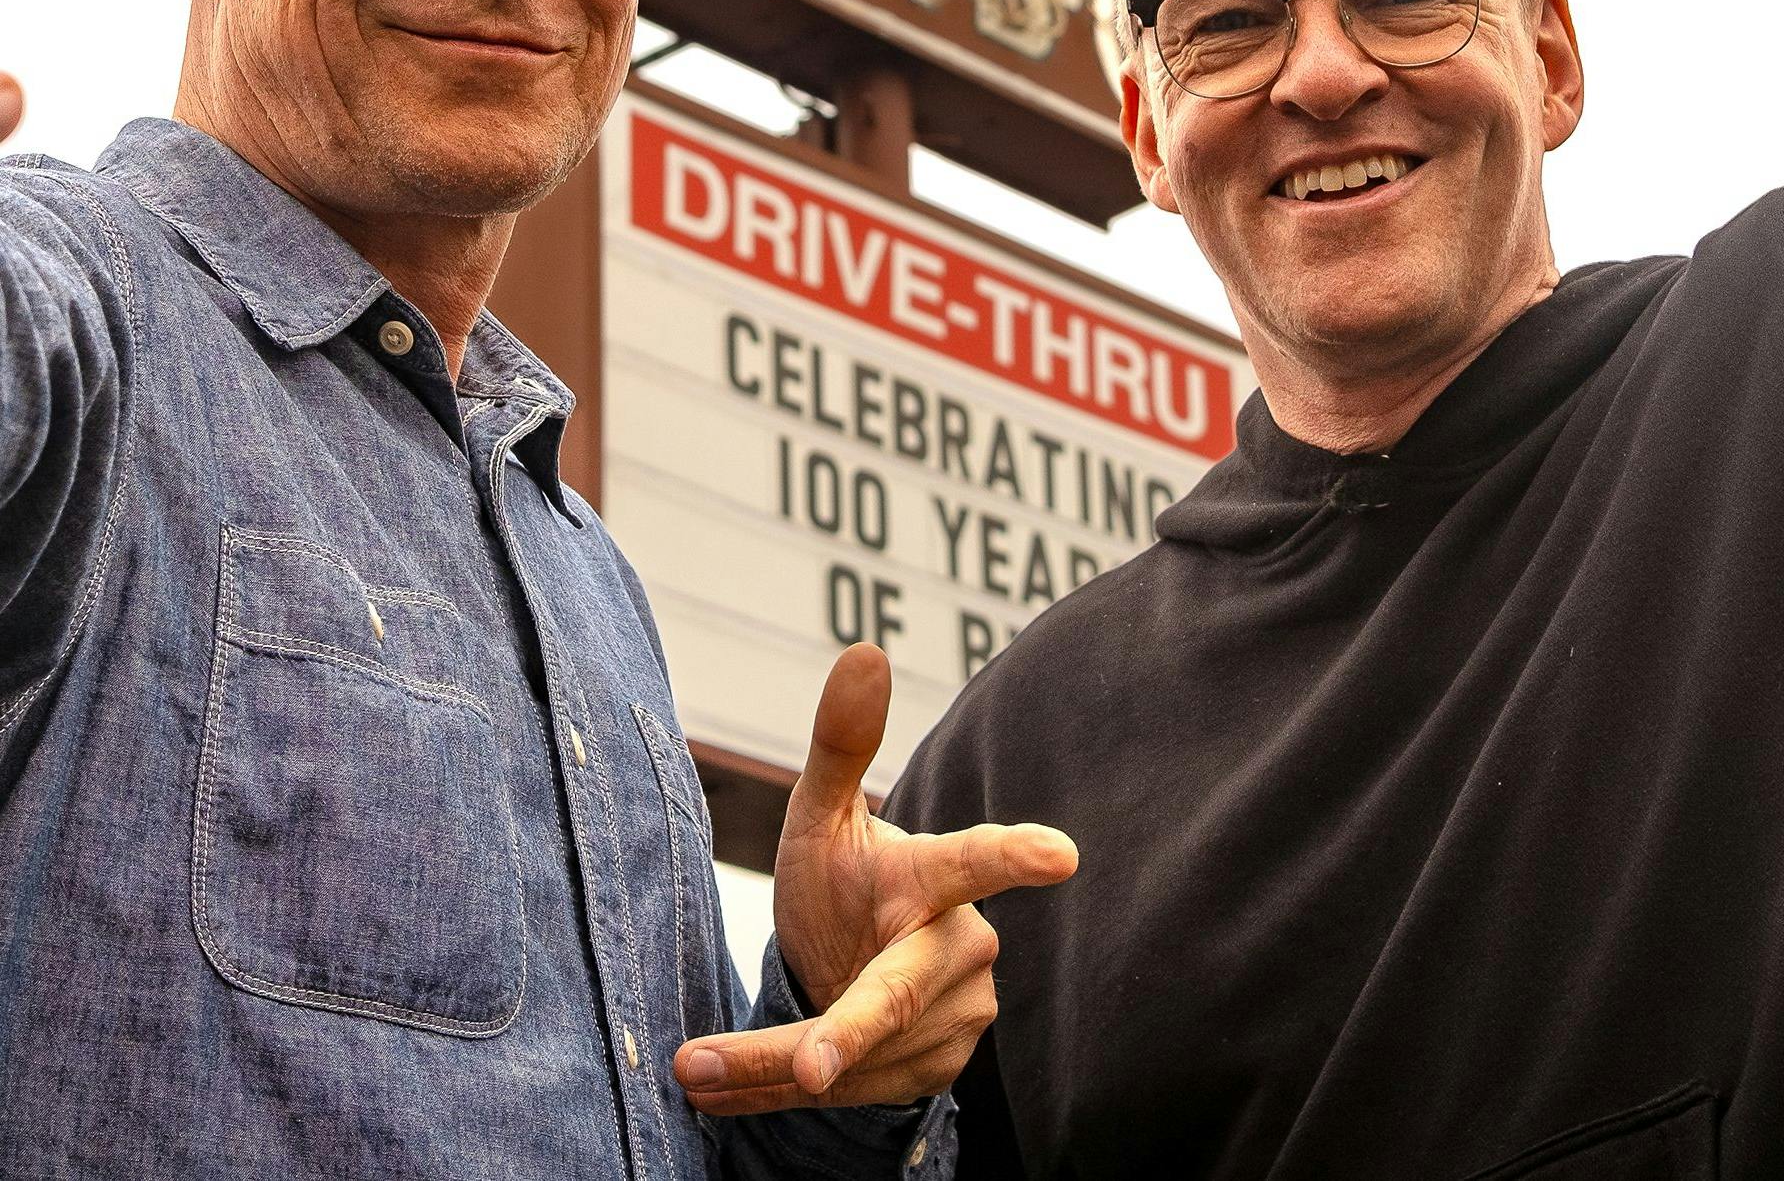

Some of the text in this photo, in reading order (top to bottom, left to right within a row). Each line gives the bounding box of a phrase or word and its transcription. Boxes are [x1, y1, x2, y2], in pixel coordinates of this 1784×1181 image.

[664, 141, 1209, 442] DRIVE-THRU
[779, 437, 889, 553] 100
[827, 566, 904, 648] OF
